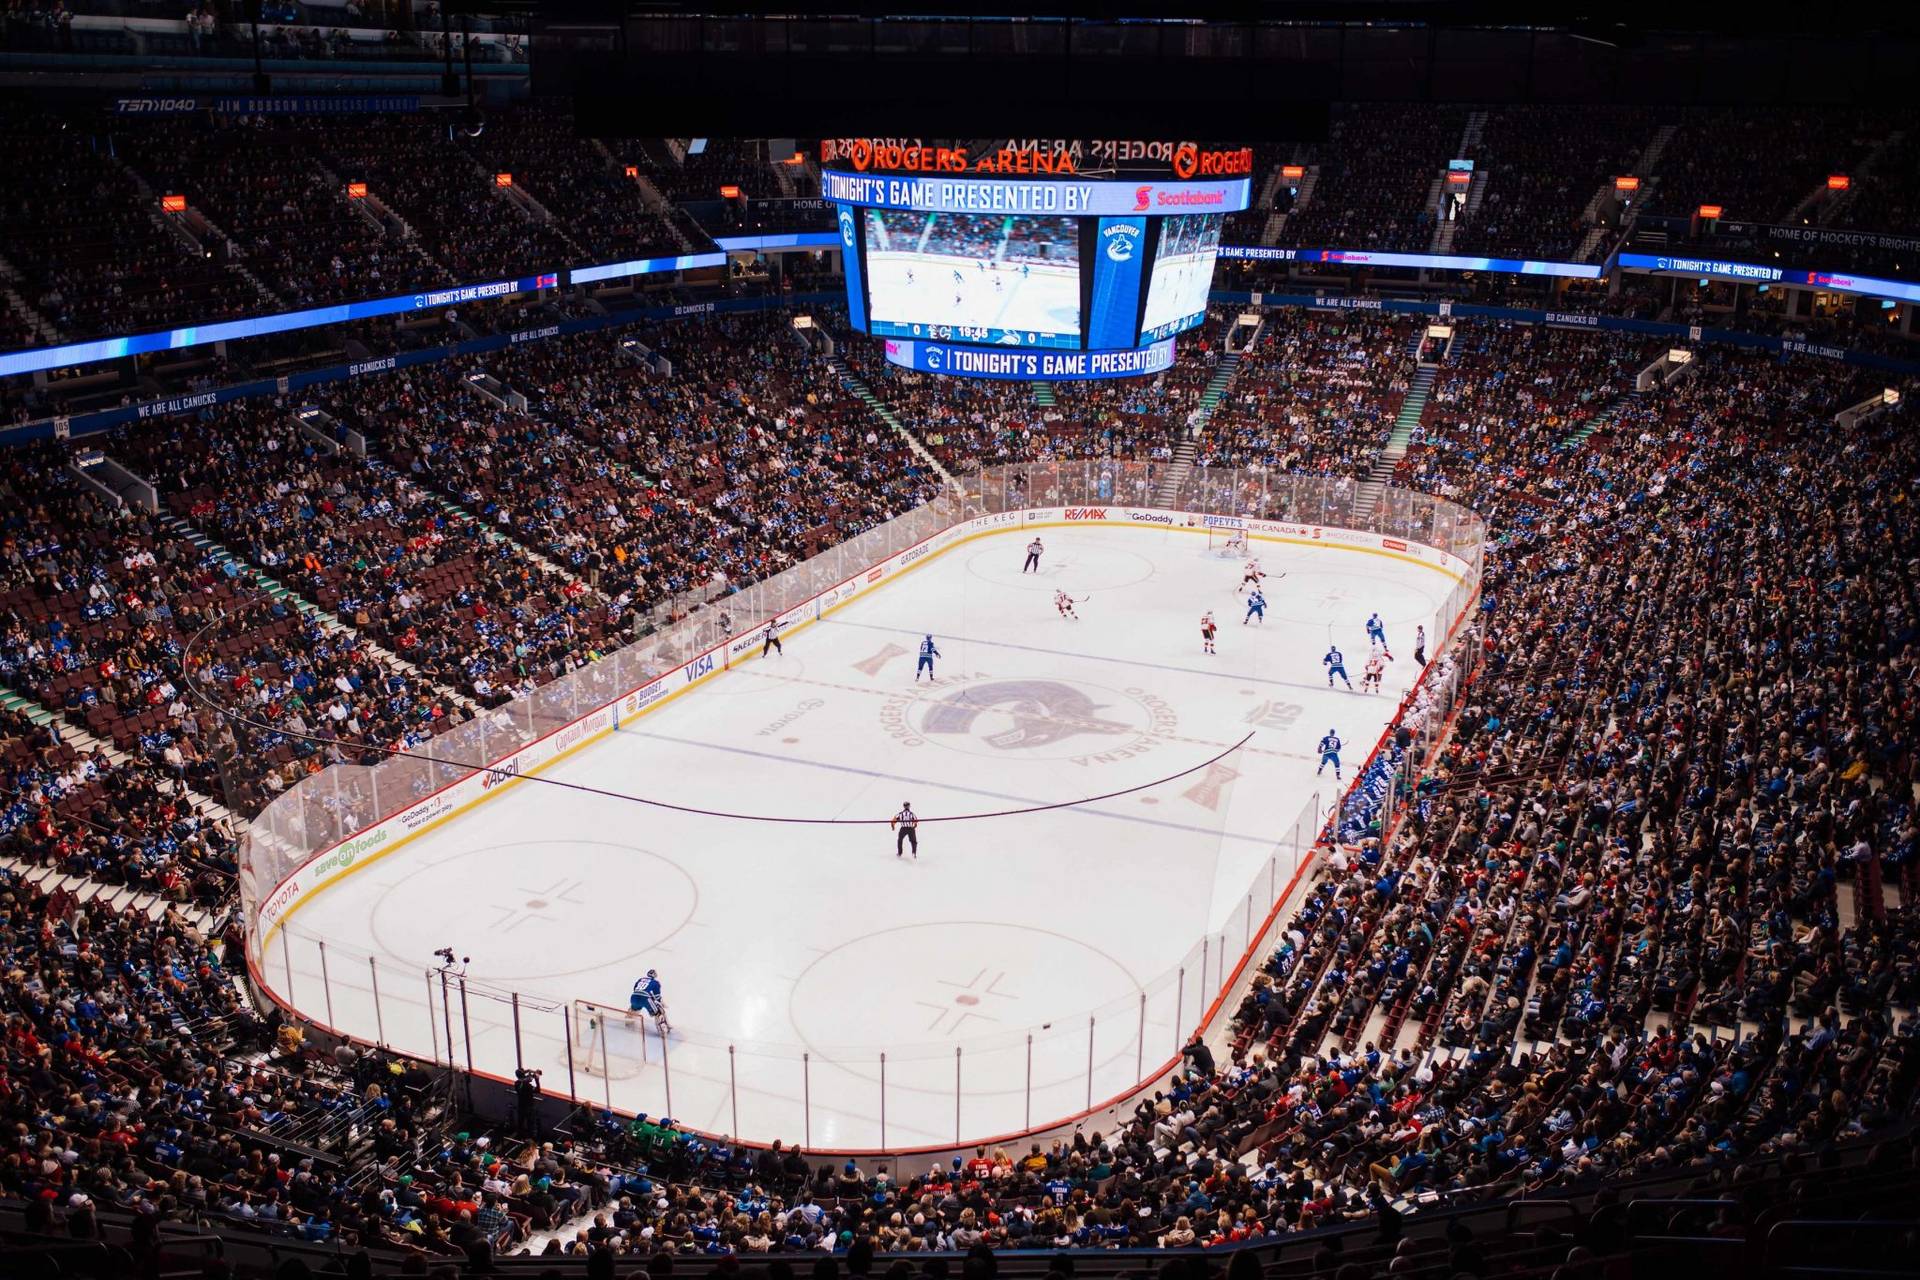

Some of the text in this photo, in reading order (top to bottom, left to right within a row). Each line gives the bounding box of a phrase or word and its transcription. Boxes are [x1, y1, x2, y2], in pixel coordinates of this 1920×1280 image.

[219, 100, 240, 112] JIM
[250, 100, 299, 112] ROBSON
[874, 146, 968, 173] ROGERS
[976, 149, 1075, 174] ARENA
[830, 175, 1092, 211] TONIGHT'S GAME PRESENTED BY
[1157, 191, 1224, 206] Scotiabank
[1769, 228, 1800, 241] HOME
[1803, 231, 1819, 242] OF
[1820, 232, 1877, 247] HOCKEY'S
[1226, 248, 1244, 257] GAME
[1245, 249, 1285, 259] PRESENTED
[1286, 250, 1297, 260] BY
[1673, 260, 1783, 280] TONIGHT'S GAME PRESENTED BY
[428, 280, 518, 306] TONIGHT'S GAME PRESENTED BY
[1315, 297, 1382, 310] WE ARE ALL CANUCKS
[1546, 312, 1598, 326] GO CANUCKS GO
[913, 324, 920, 336] 0
[1028, 333, 1036, 345] 0
[1783, 340, 1845, 360] WE ARE ALL CANUCKS
[350, 357, 396, 375] GO CANUCKS GO
[953, 351, 1037, 375] TONIGHT'S
[1043, 355, 1087, 375] GAME
[1091, 350, 1157, 374] PRESENTED
[138, 393, 217, 418] WE ARE ALL CANUCKS
[55, 421, 69, 432] 105
[972, 518, 987, 528] THE
[994, 512, 1015, 523] KEG
[1064, 508, 1107, 520] RE/MAX
[1132, 513, 1173, 525] GoDaddy
[1203, 515, 1243, 528] POPEYE'S
[1262, 525, 1297, 534] CANADA
[901, 543, 929, 566] GATORADE
[733, 624, 772, 655] SKECHER
[685, 654, 714, 682] VISA
[639, 681, 661, 701] BUDGET
[756, 709, 806, 738] TOYOTA
[880, 697, 909, 739] ROGERS
[556, 713, 607, 752] Captain Morgan
[1070, 693, 1178, 768] ROGERS ARENA
[488, 756, 519, 789] Abell
[401, 806, 430, 823] GoDaddy
[408, 819, 422, 829] Make
[315, 856, 338, 877] save
[355, 829, 387, 854] foods
[266, 881, 300, 922] TOYOTA
